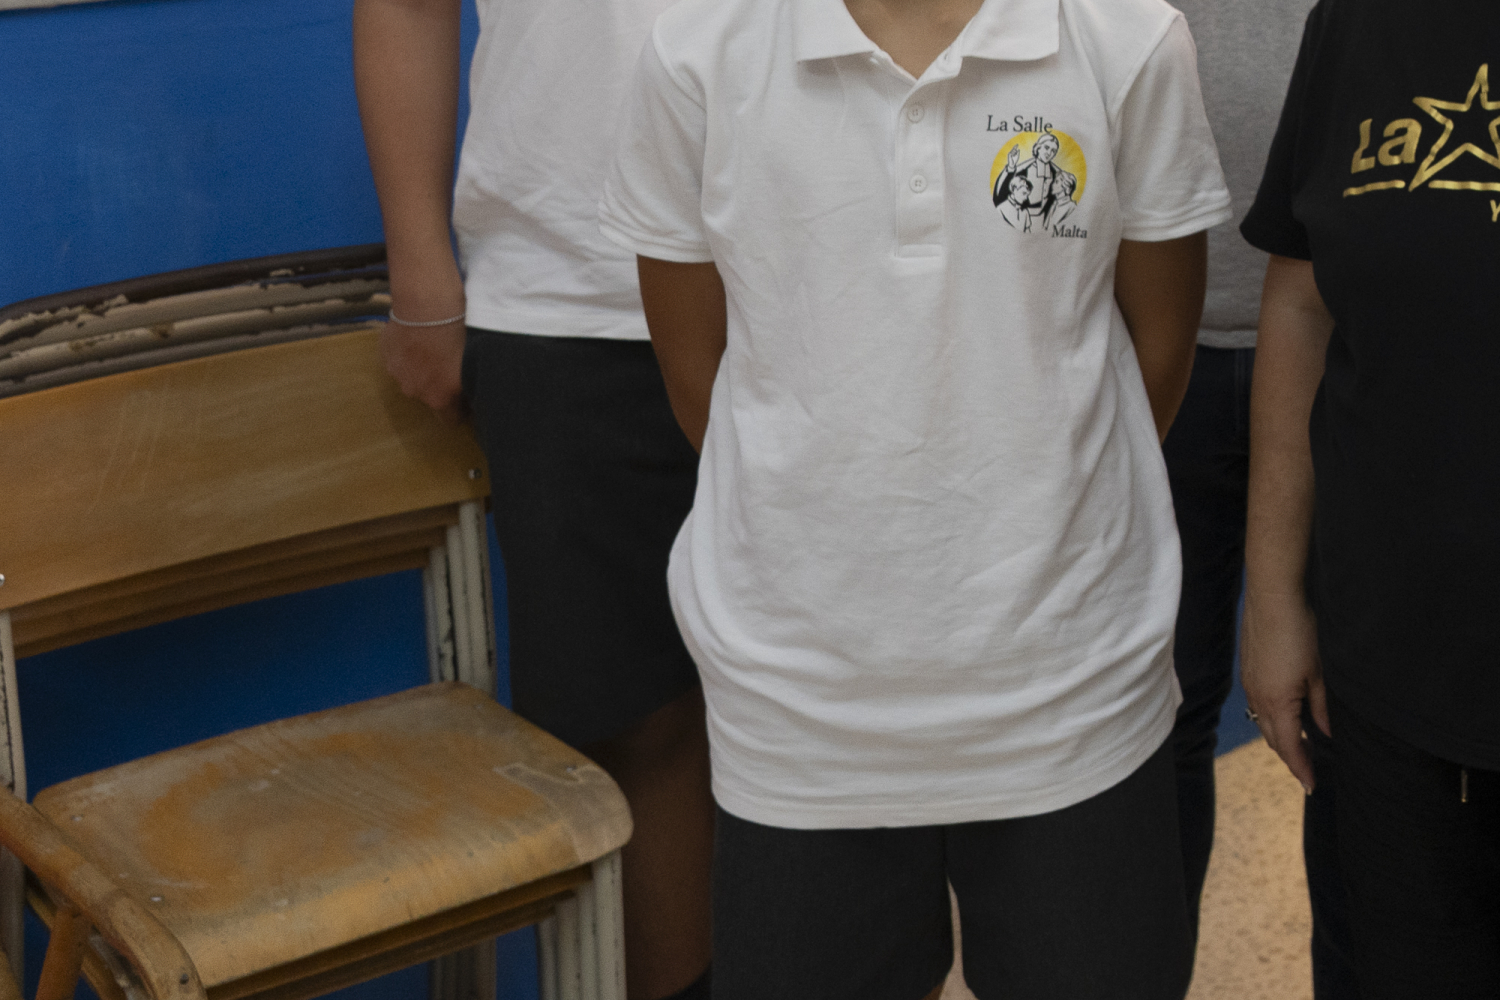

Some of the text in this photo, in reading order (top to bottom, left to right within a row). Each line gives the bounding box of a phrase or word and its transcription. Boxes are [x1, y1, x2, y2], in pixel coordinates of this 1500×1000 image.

[986, 114, 1053, 134] La Salle
[1351, 118, 1422, 174] La
[1052, 224, 1088, 239] Malta
